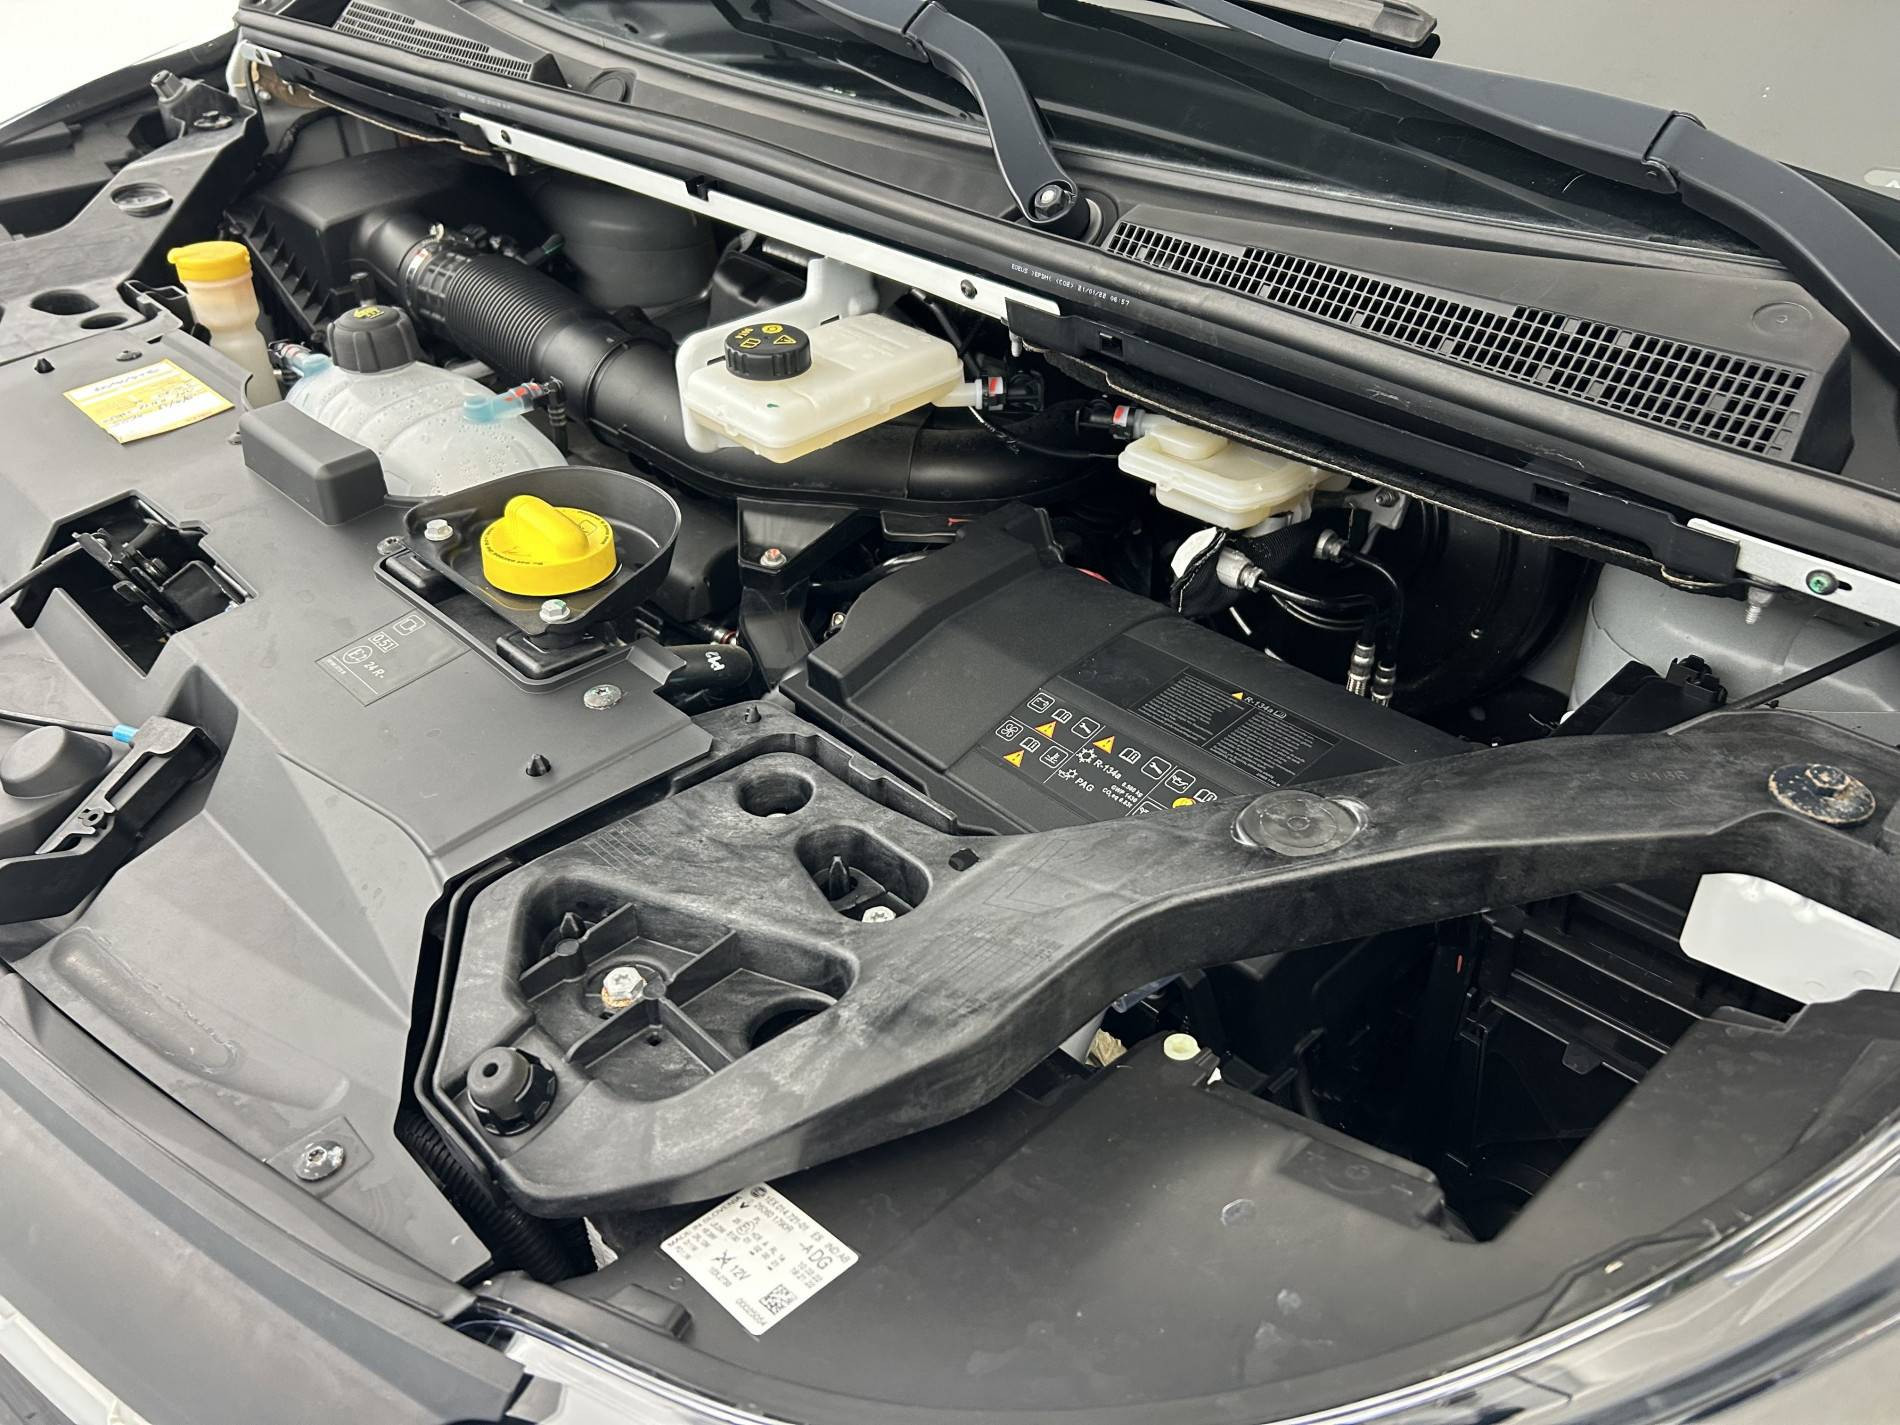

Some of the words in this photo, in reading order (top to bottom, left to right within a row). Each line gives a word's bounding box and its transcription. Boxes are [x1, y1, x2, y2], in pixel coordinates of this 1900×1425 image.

[1244, 696, 1274, 713] R-134a
[1093, 759, 1122, 780] R-134a
[1074, 777, 1095, 792] PAG
[1110, 784, 1126, 794] GWP
[1124, 792, 1139, 803] 1430
[728, 1263, 752, 1282] 12V
